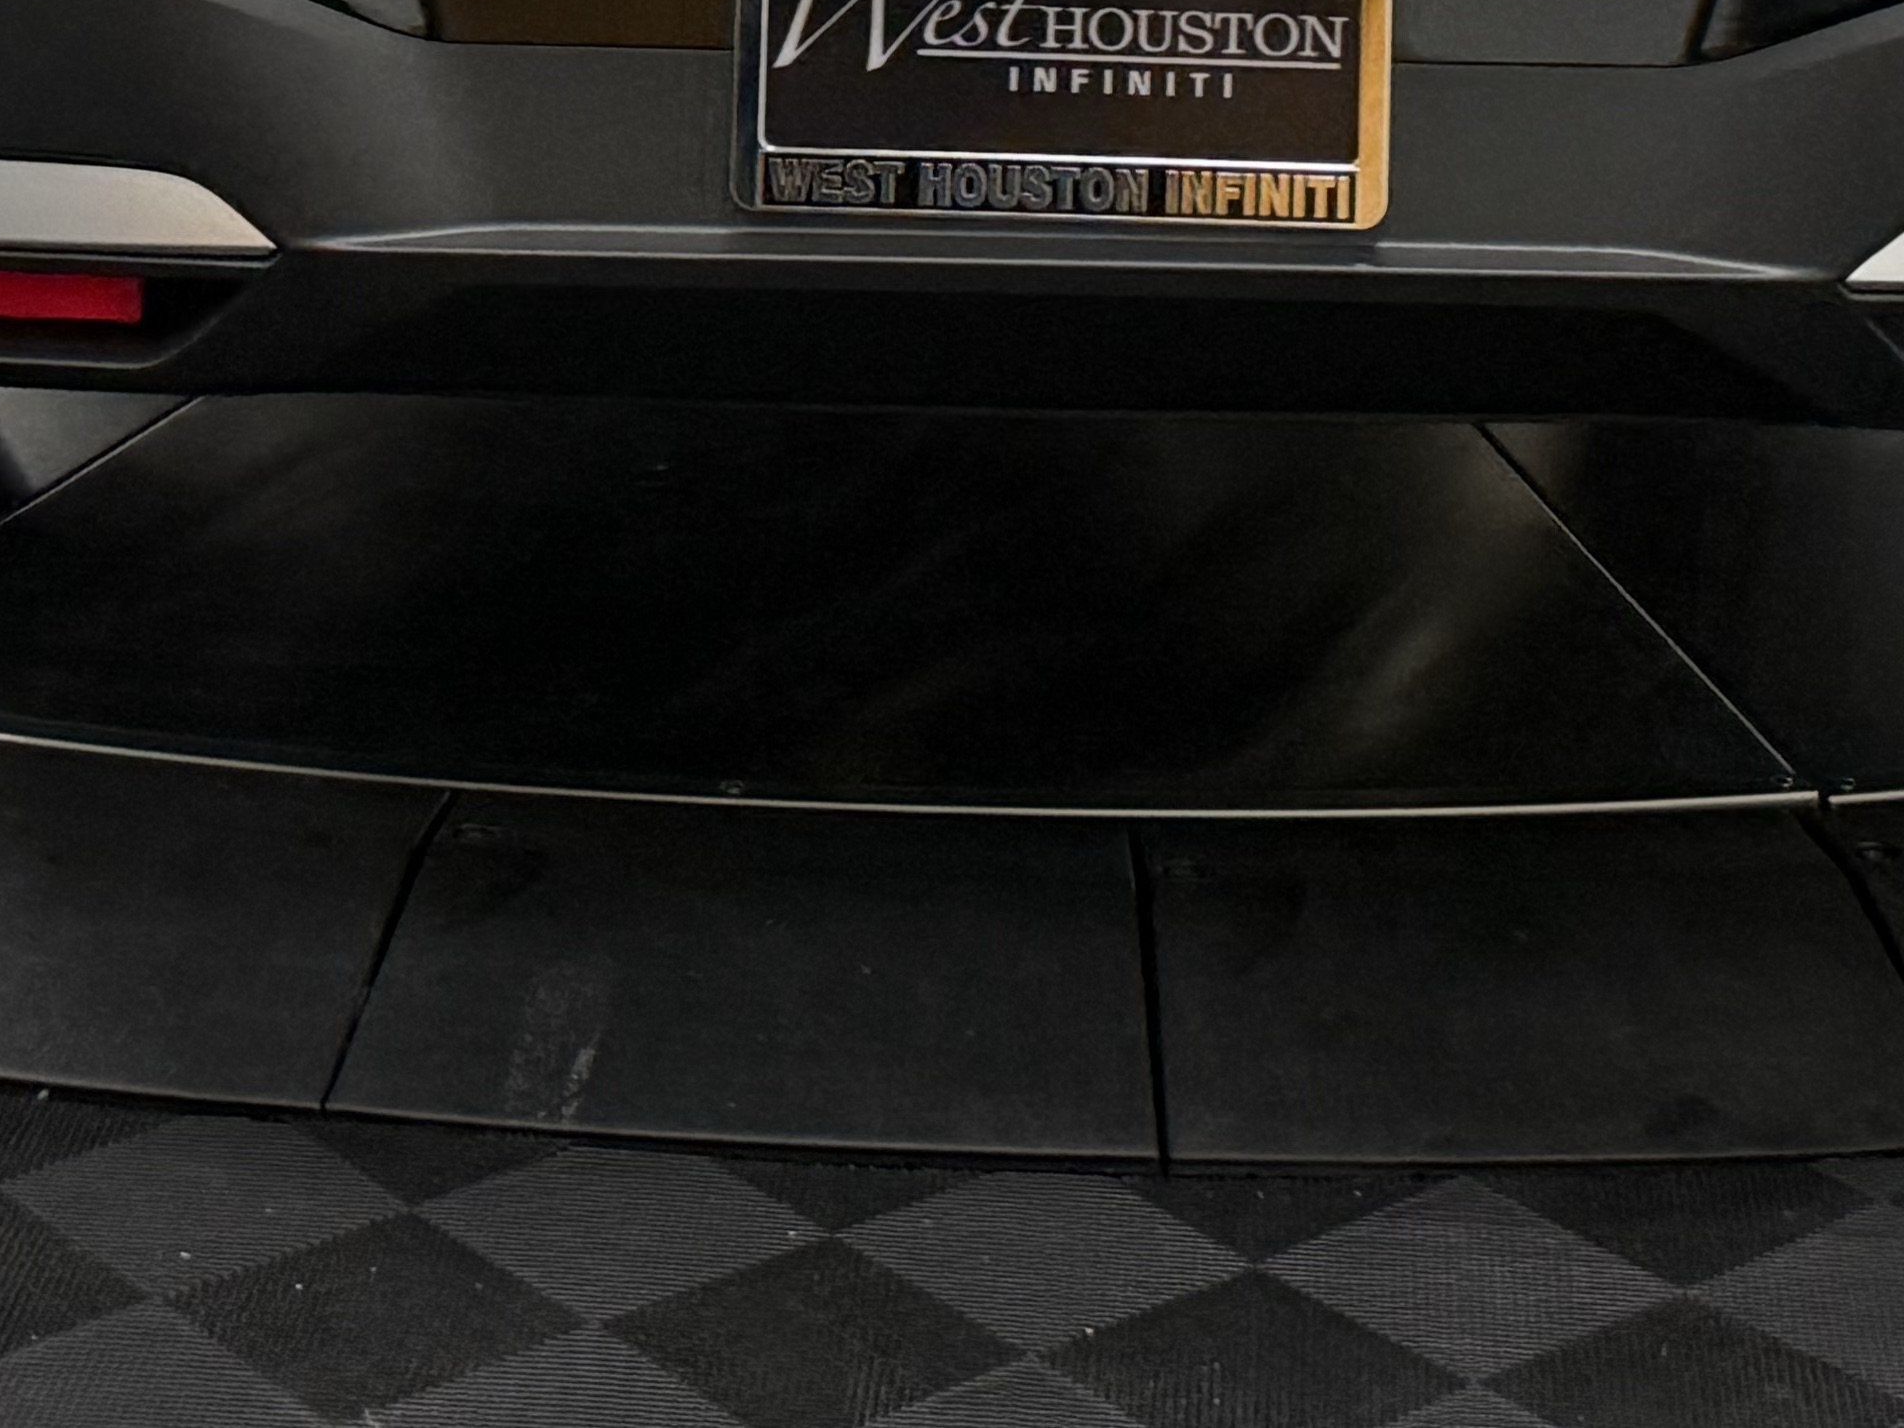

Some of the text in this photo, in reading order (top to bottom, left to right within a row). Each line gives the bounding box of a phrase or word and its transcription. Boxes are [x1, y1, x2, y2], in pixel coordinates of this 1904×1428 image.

[1041, 6, 1350, 59] HOUSTON
[1008, 66, 1235, 99] INFINITI
[768, 158, 1352, 220] WEST HOUSTON INFINITI
